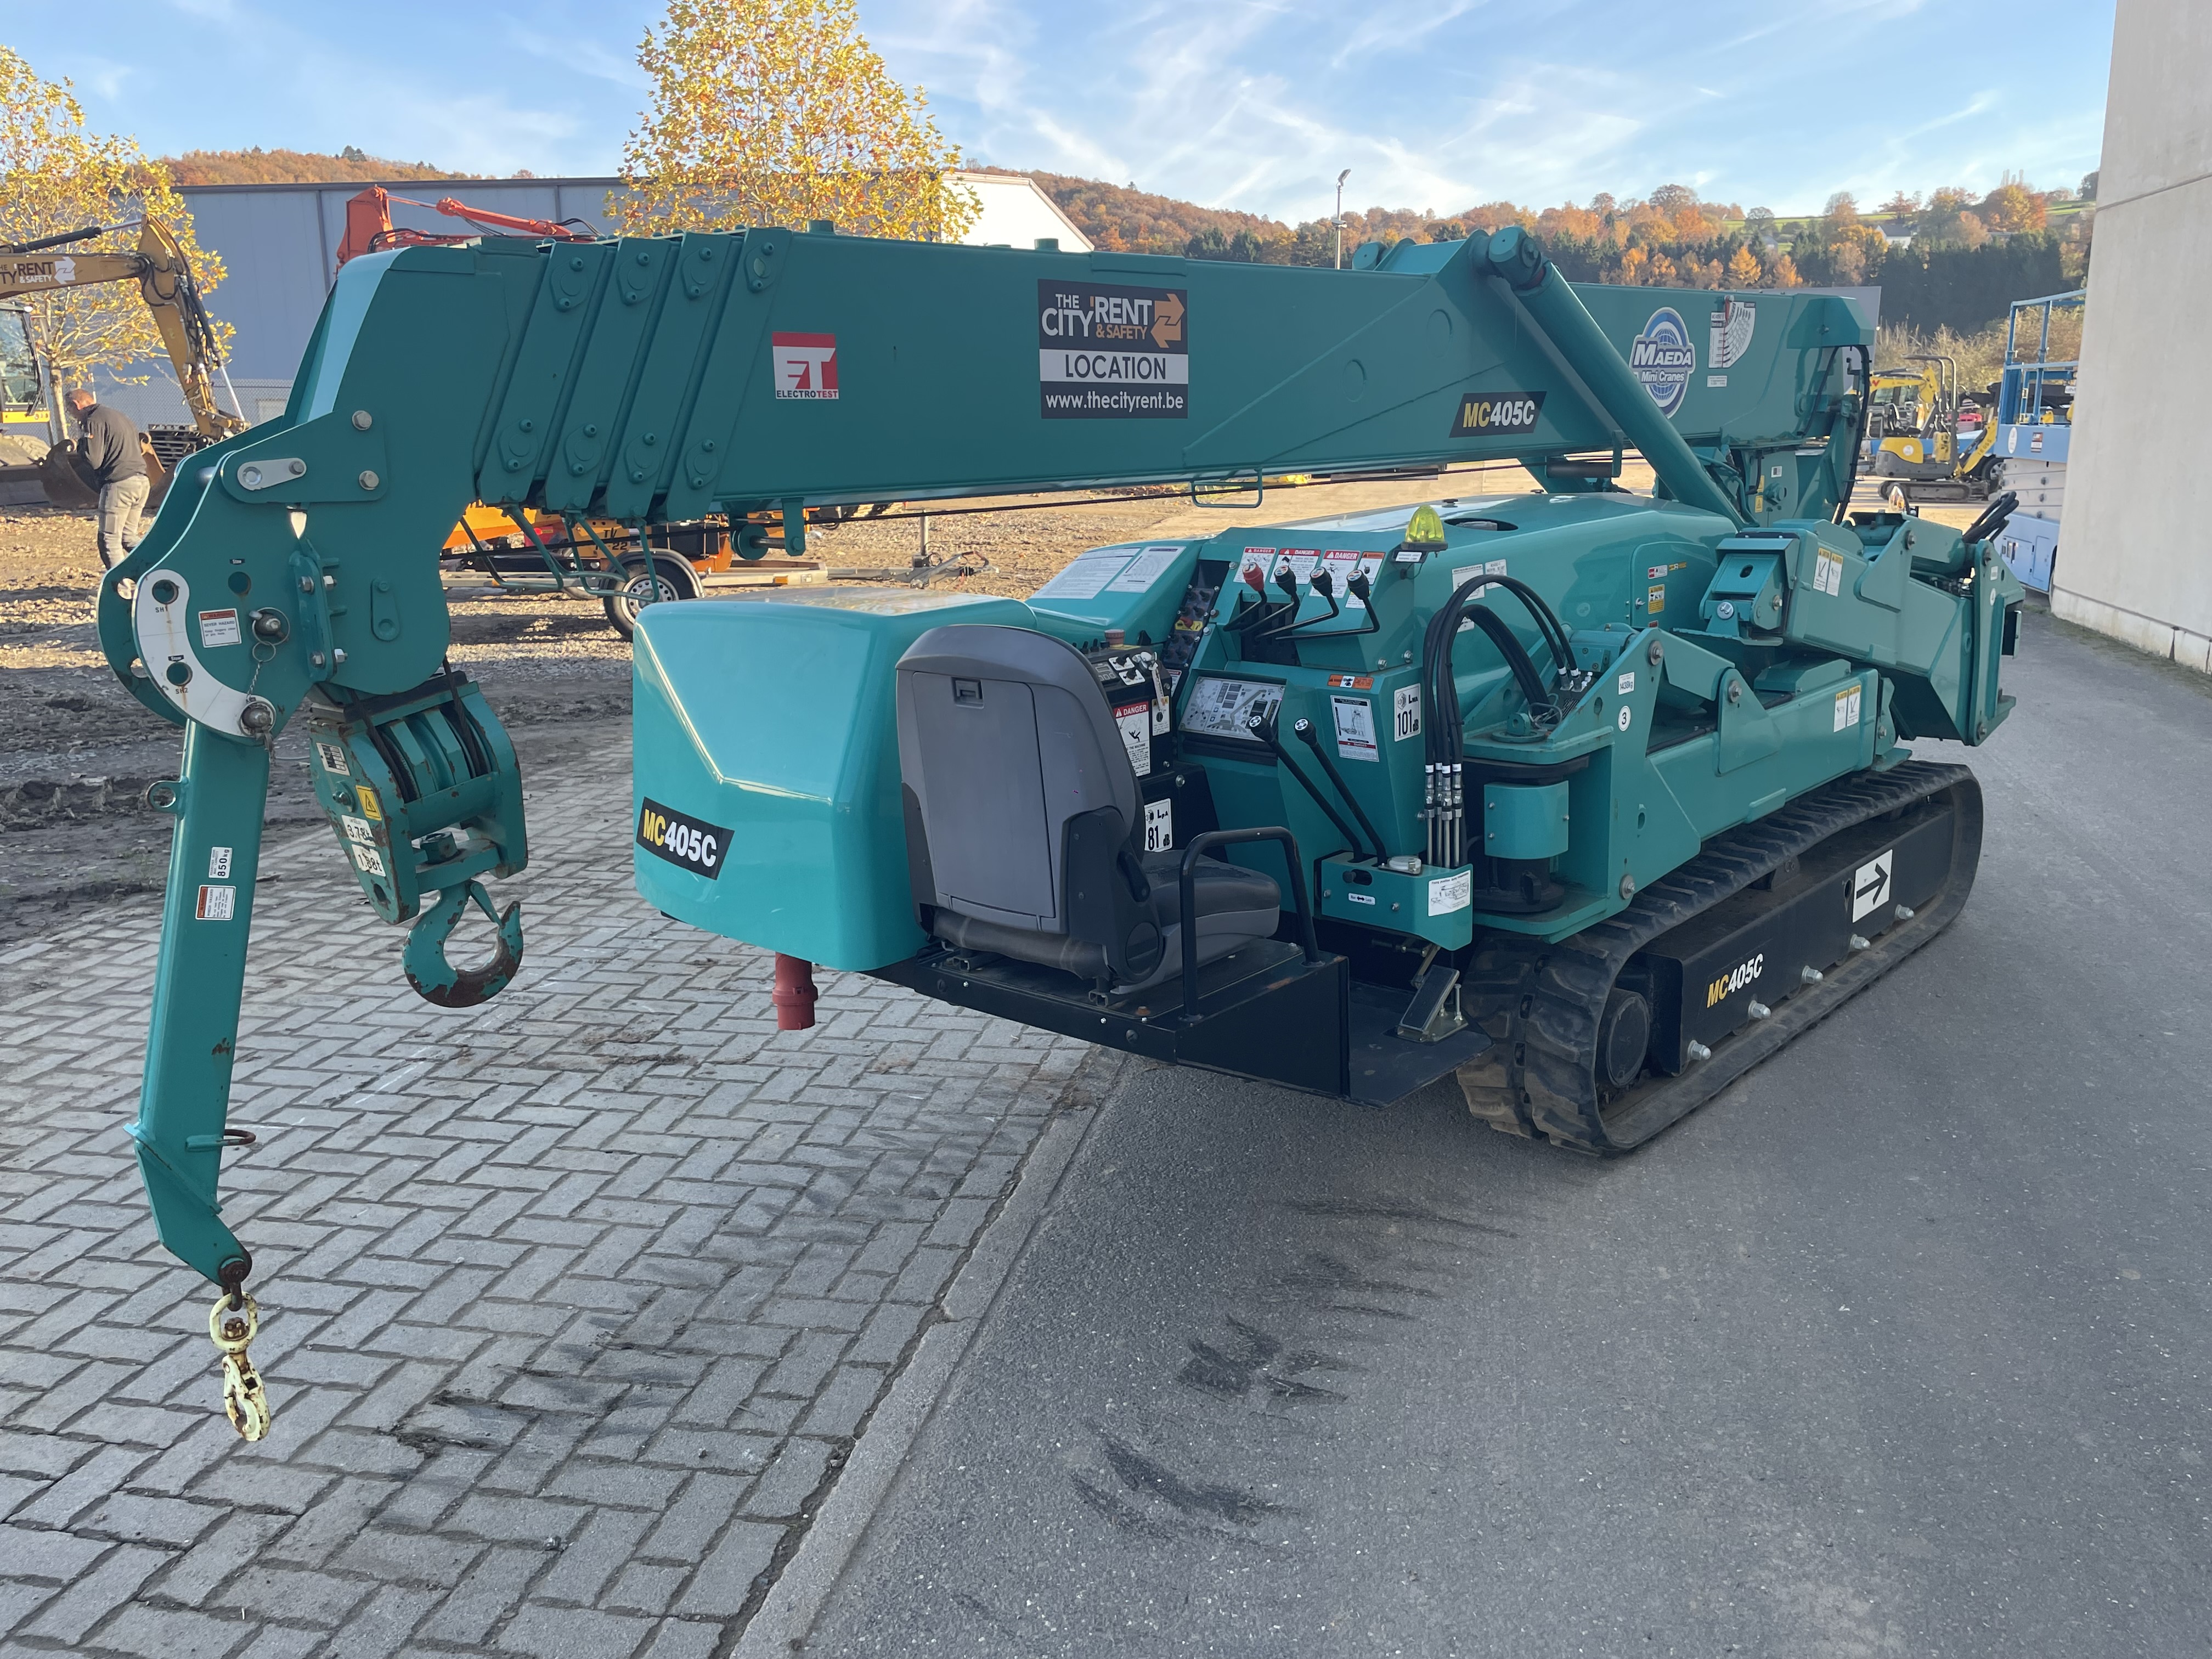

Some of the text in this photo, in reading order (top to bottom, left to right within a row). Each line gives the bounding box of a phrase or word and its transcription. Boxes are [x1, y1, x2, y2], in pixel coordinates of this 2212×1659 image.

[26, 275, 52, 283] SAFETY
[1056, 294, 1080, 309] THE
[1042, 307, 1094, 337] CITY
[1096, 324, 1148, 340] & SAFETY
[1633, 343, 1692, 366] MAEDA
[1065, 354, 1166, 380] LOCATION
[1641, 371, 1685, 383] Mini Cranes
[776, 390, 838, 398] ELECTROTEST
[1045, 391, 1184, 413] www.thecityrent.be
[1463, 400, 1535, 428] MC405C
[1334, 551, 1357, 560] DANGER
[1123, 704, 1147, 715] DANGER
[1622, 712, 1627, 725] 3
[1397, 709, 1412, 736] 101
[643, 808, 717, 867] MC405C
[1148, 825, 1159, 850] 81
[1706, 953, 1763, 1008] MC405C
